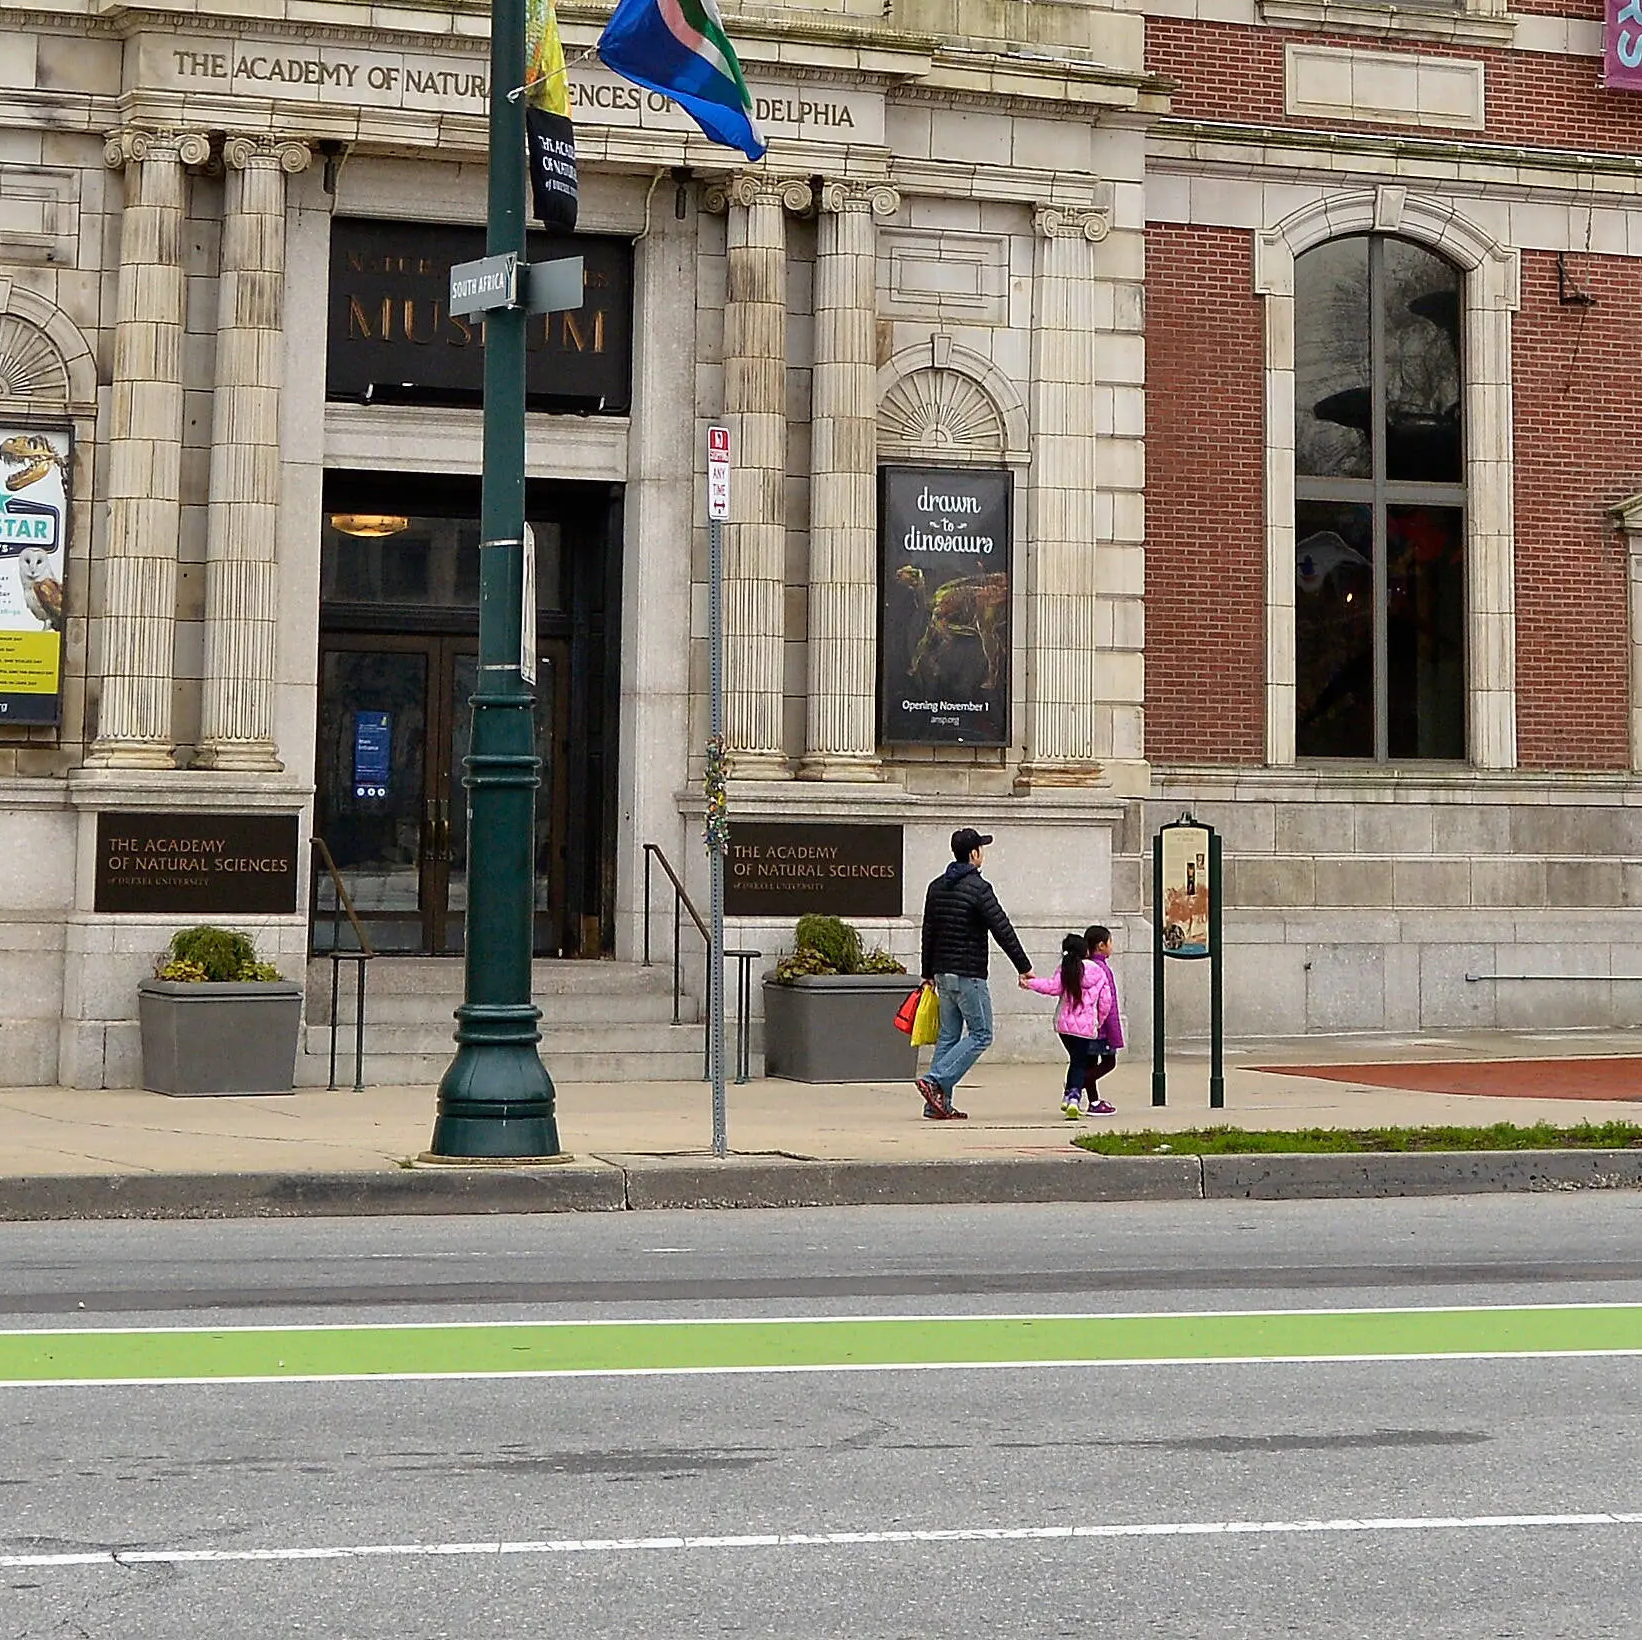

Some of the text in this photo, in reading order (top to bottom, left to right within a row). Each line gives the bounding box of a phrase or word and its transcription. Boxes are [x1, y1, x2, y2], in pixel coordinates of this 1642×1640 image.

[173, 49, 228, 78] THE
[233, 55, 360, 90] ACADEMY
[367, 65, 400, 91] OF
[405, 68, 491, 99] NATUR
[568, 82, 641, 111] ENCES
[755, 97, 856, 128] DELPHIA
[452, 271, 505, 300] SOUTH AFRICA
[916, 486, 981, 514] drawn
[904, 526, 994, 554] dinosaurs
[902, 700, 938, 713] Opening
[940, 701, 984, 712] November
[108, 838, 226, 853] THE ACADEMY
[733, 844, 838, 860] THE ACADEMY
[108, 856, 288, 873] OF NATURAL SCIENCES
[733, 863, 895, 879] OF NATURAL SCIENCES
